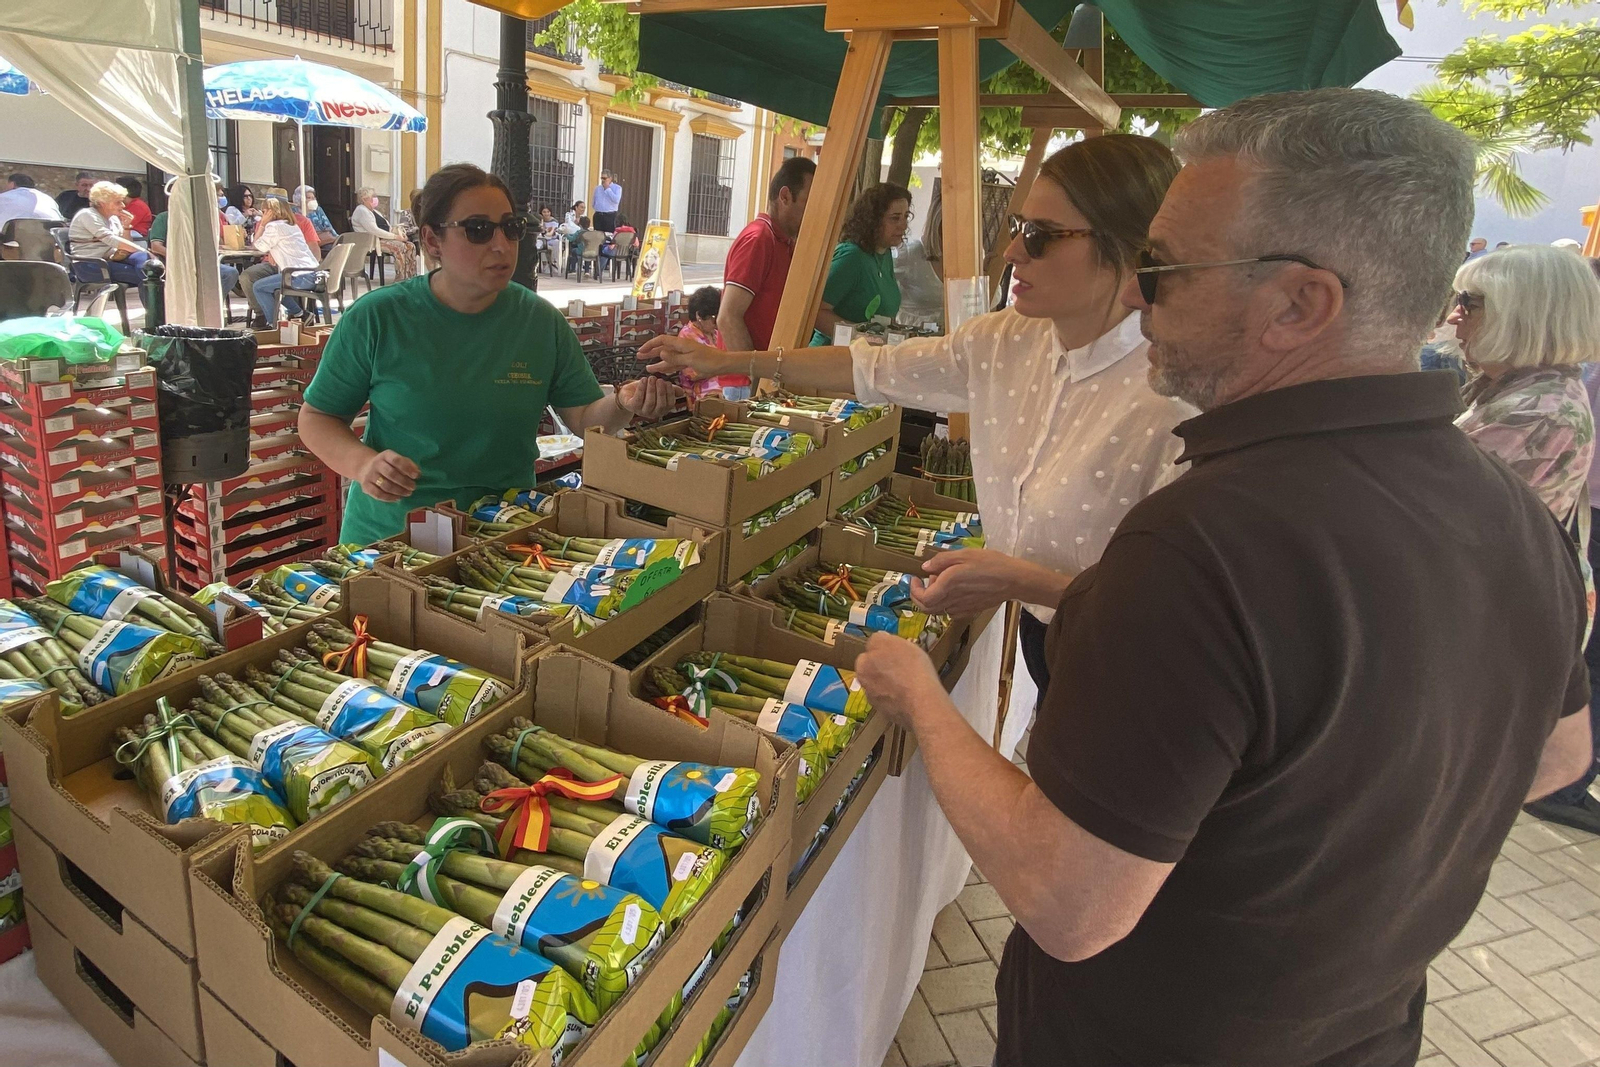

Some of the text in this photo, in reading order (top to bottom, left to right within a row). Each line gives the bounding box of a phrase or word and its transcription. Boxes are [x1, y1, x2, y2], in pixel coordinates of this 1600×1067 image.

[206, 86, 306, 108] HELADO
[640, 566, 672, 586] OFERTA
[803, 667, 814, 677] El
[771, 706, 781, 714] El
[400, 739, 412, 749] DEL
[253, 747, 265, 763] El
[164, 787, 177, 804] El
[604, 817, 642, 851] El Pue
[405, 992, 424, 1020] El
